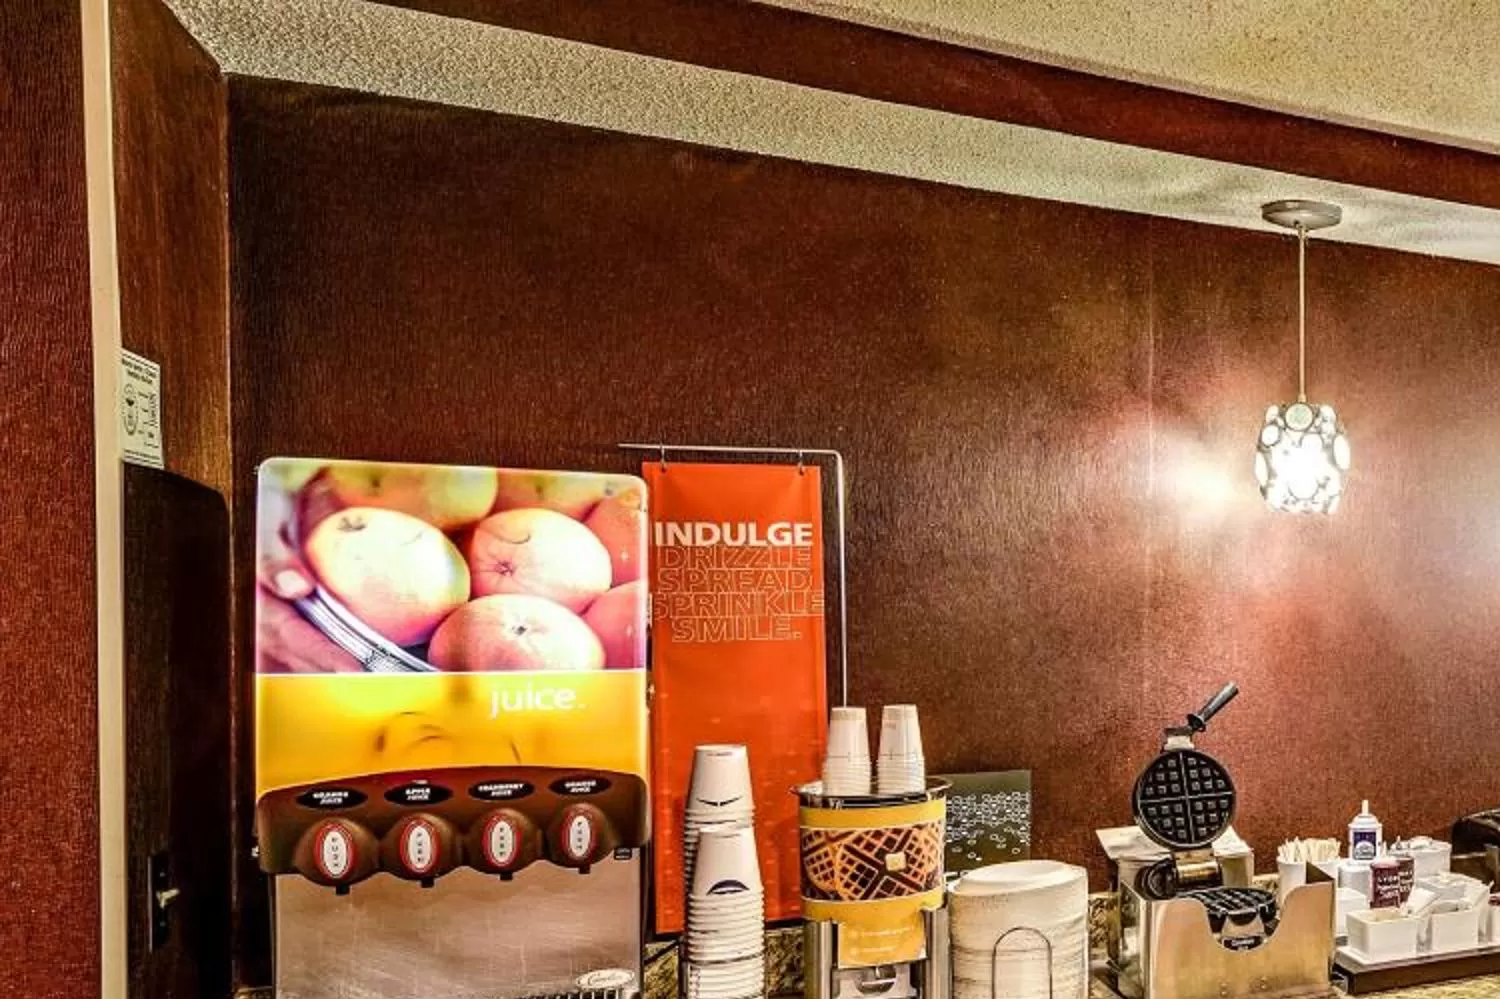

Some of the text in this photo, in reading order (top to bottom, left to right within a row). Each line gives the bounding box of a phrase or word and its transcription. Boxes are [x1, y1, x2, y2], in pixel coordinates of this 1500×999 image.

[655, 521, 814, 547] INDULGE
[658, 546, 812, 570] DRIZZLE
[658, 568, 813, 592] SPREAD
[652, 592, 824, 618] SPRINKLE
[671, 616, 803, 643] SMILE.
